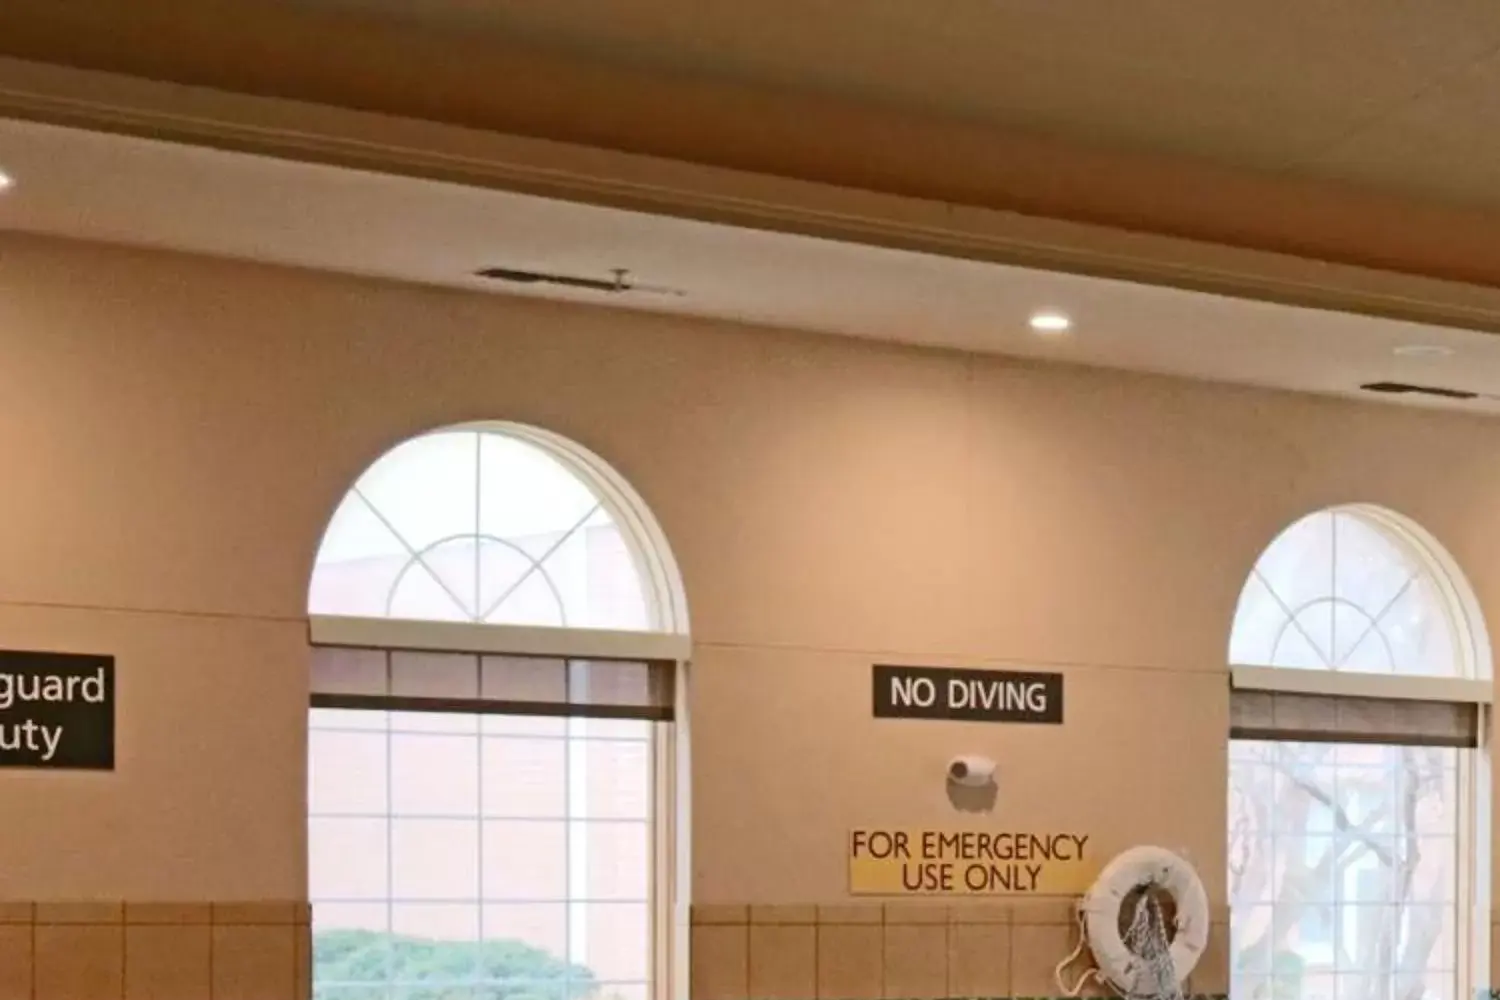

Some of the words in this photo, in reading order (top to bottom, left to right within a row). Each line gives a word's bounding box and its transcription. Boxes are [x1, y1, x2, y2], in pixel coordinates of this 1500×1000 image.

[890, 676, 936, 707] NO
[948, 678, 1047, 712] DIVING
[853, 830, 911, 859] FOR
[922, 831, 1089, 862] EMERGENCY
[903, 863, 953, 890] USE
[964, 864, 1042, 891] ONLY
